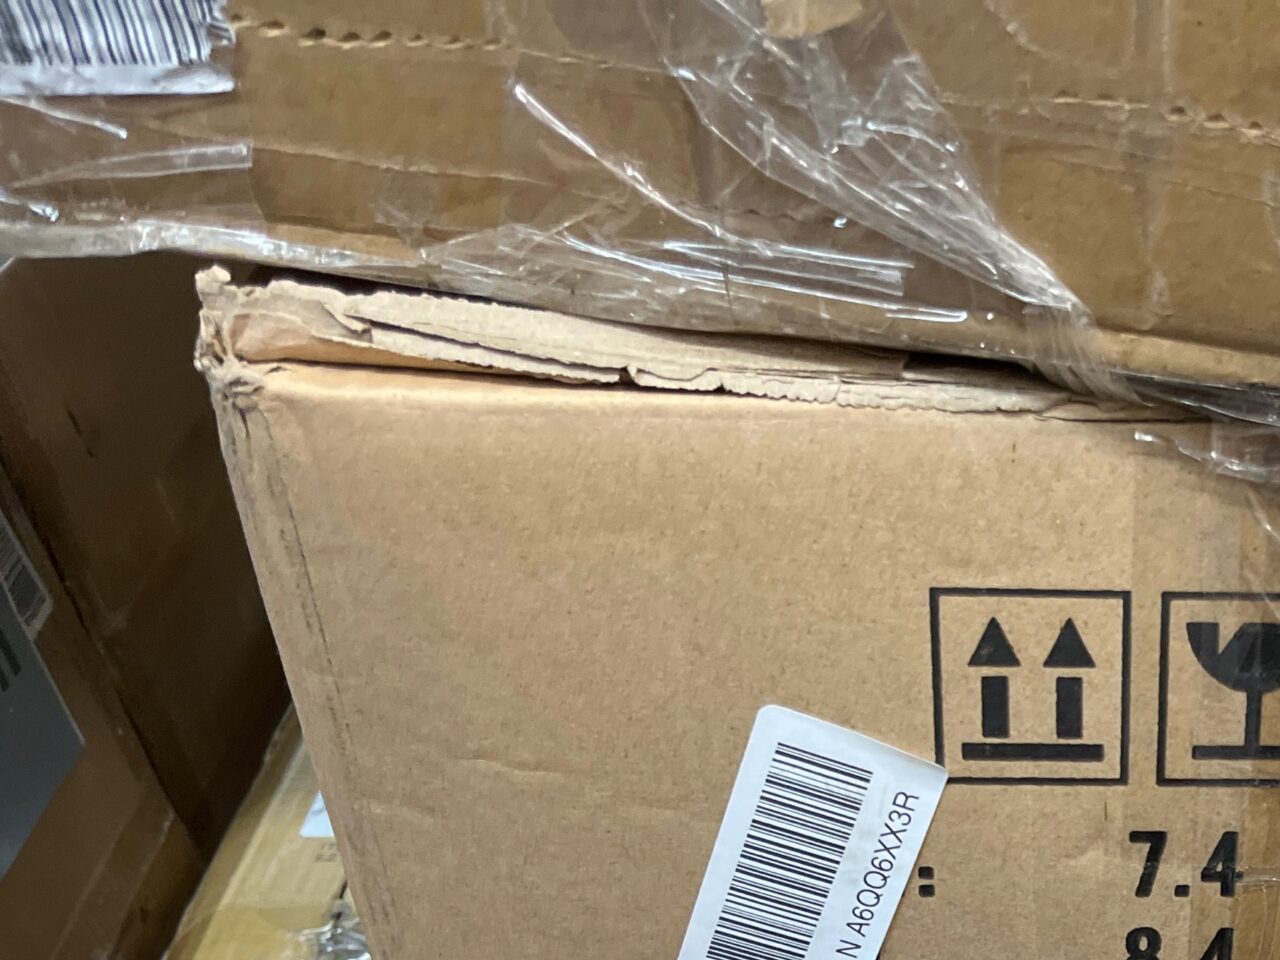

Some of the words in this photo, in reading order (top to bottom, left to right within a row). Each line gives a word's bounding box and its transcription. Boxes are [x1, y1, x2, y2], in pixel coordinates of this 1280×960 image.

[846, 790, 920, 938] A6QQ6XX3R
[1128, 830, 1244, 898] 7.4
[836, 938, 863, 959] N
